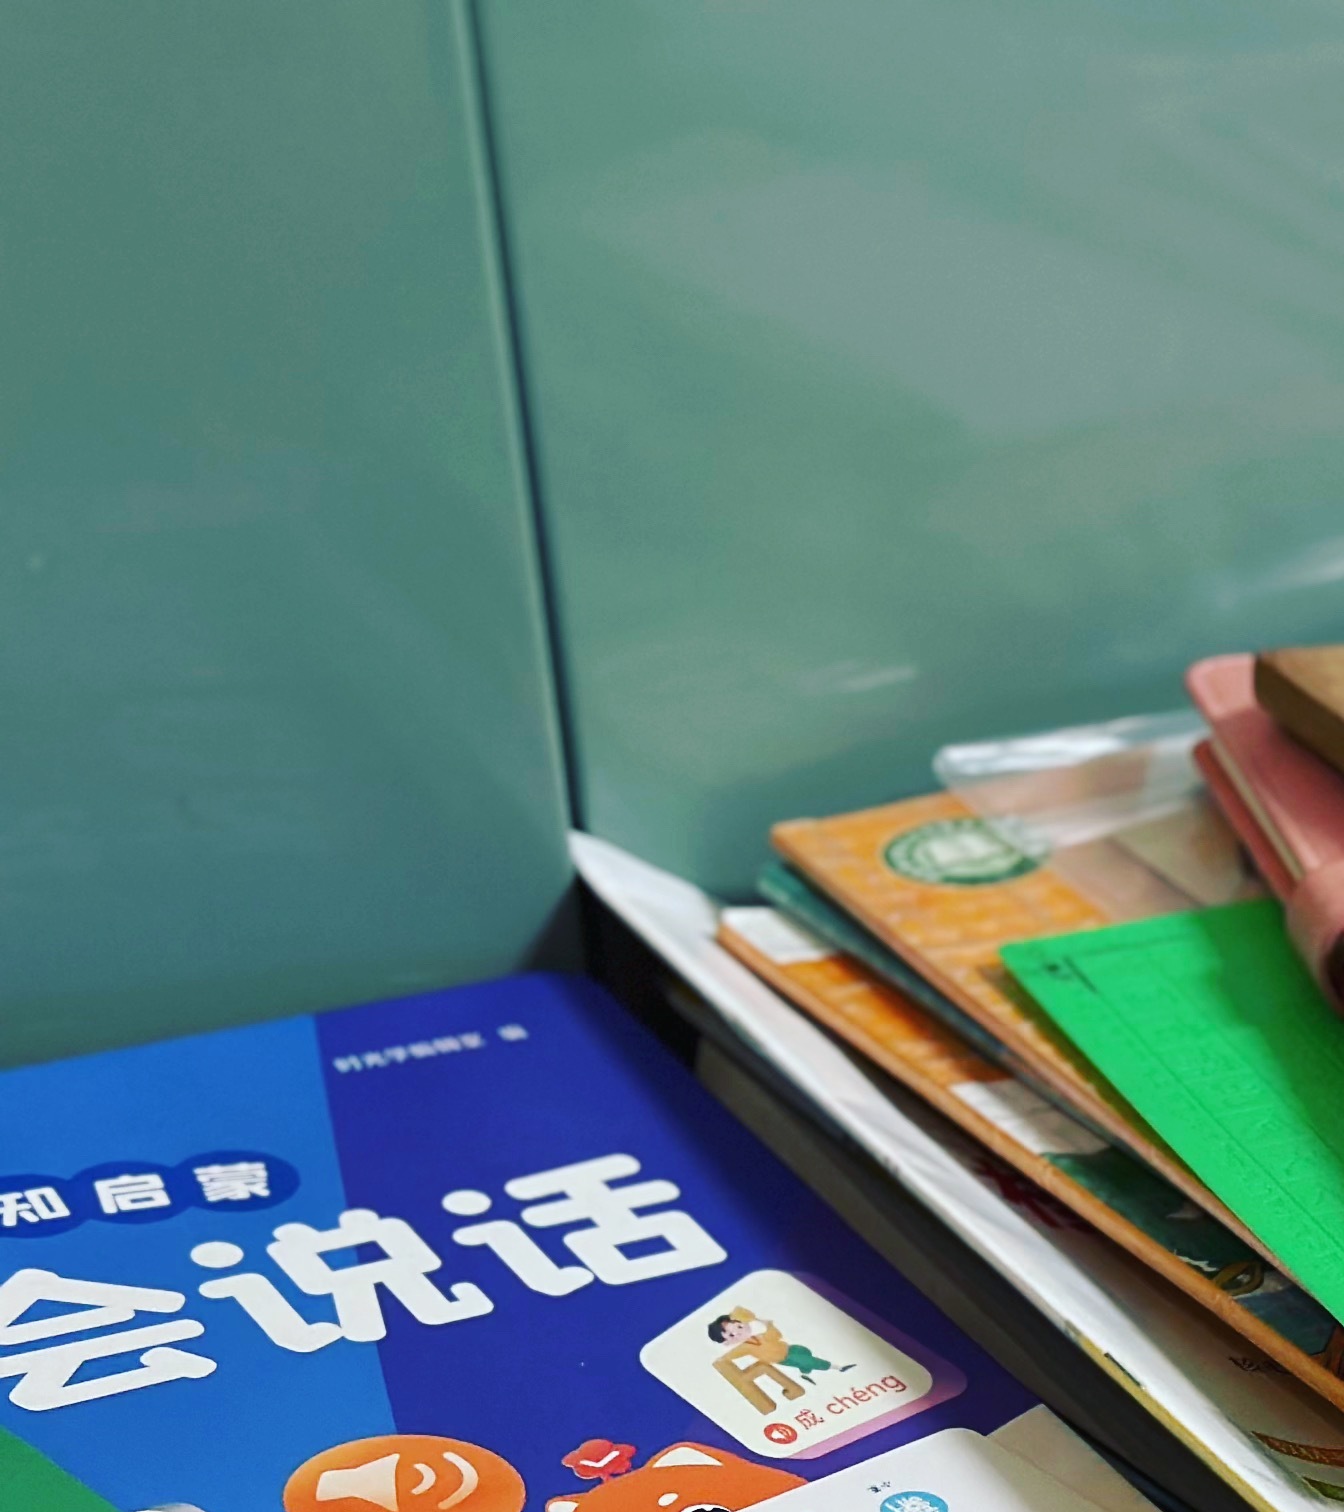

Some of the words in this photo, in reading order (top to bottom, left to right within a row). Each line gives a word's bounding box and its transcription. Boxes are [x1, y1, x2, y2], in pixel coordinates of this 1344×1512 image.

[0, 1153, 728, 1411] 会说话
[794, 1408, 825, 1430] 成
[826, 1373, 908, 1415] chéng
